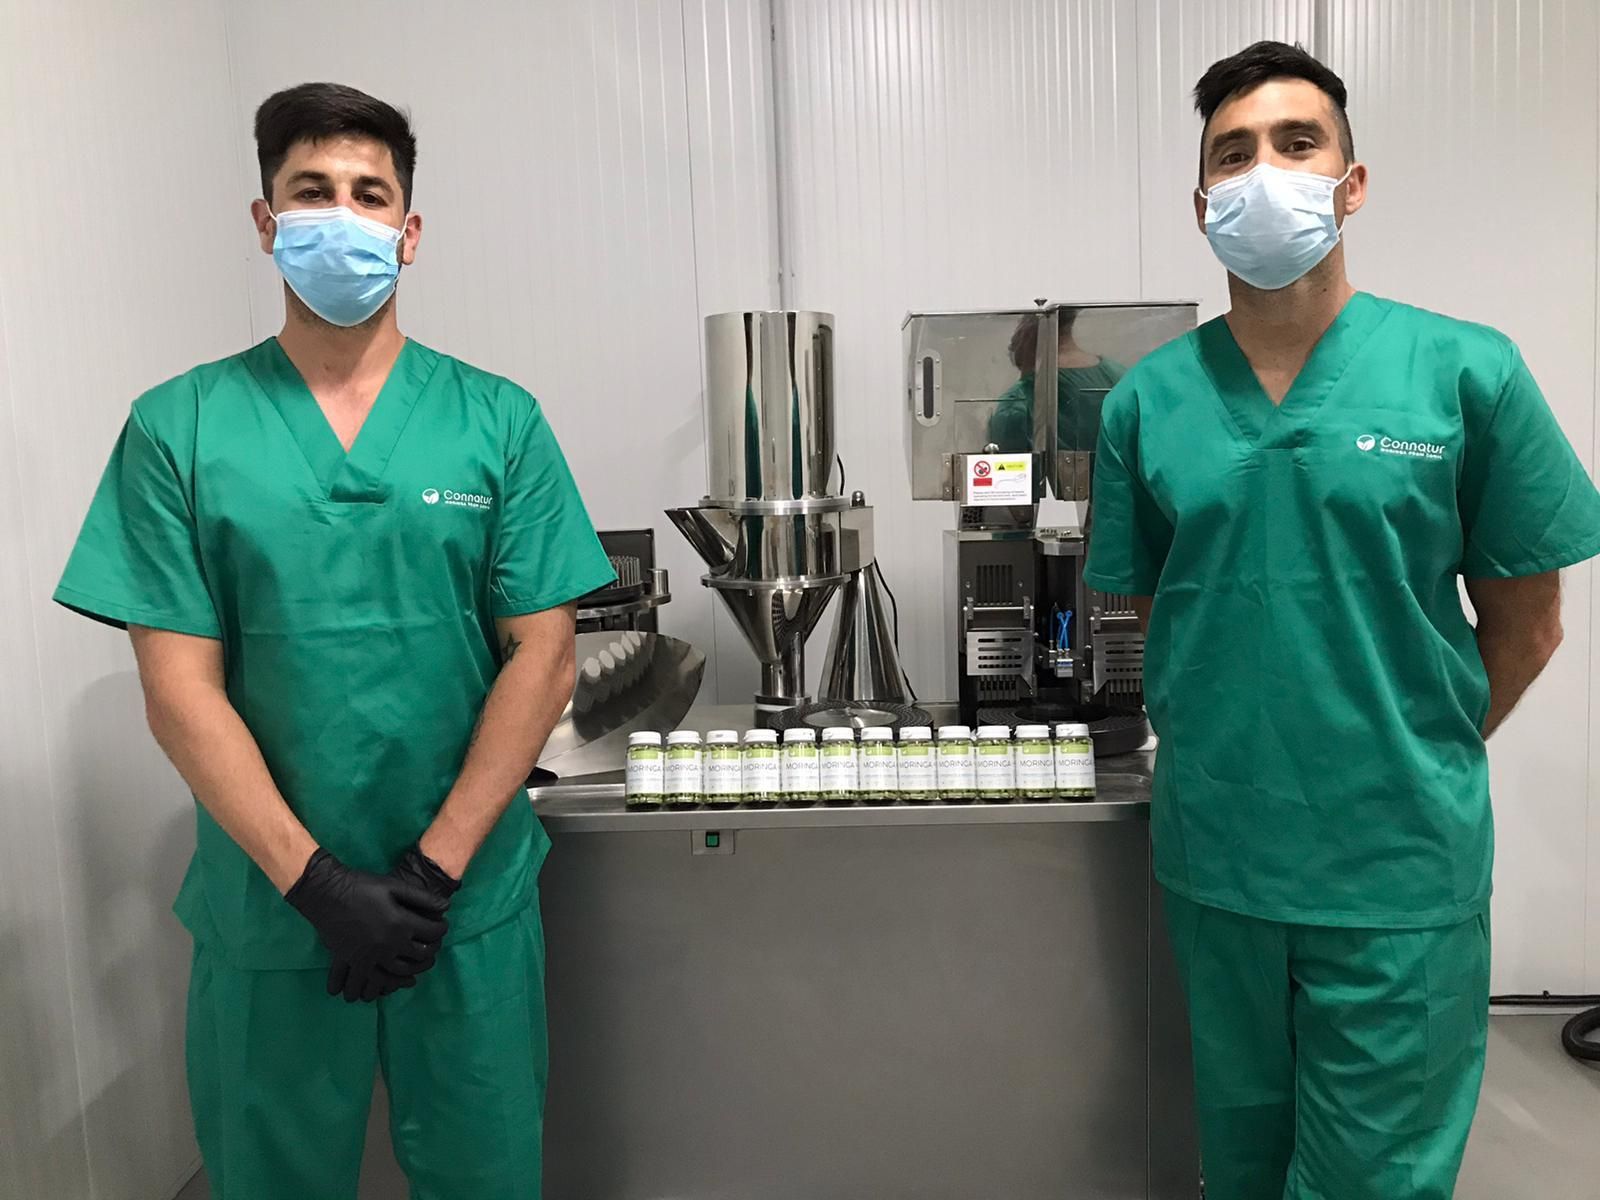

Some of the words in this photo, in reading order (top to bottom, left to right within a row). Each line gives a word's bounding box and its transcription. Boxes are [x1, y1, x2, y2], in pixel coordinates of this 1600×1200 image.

[1380, 436, 1446, 454] Connatur
[443, 489, 493, 505] Connatur
[744, 762, 778, 771] MORINGA
[822, 761, 856, 769] MORINGA
[899, 760, 933, 768] MORINGA
[938, 759, 973, 768] MORINGA
[977, 759, 1012, 768] MORINGA
